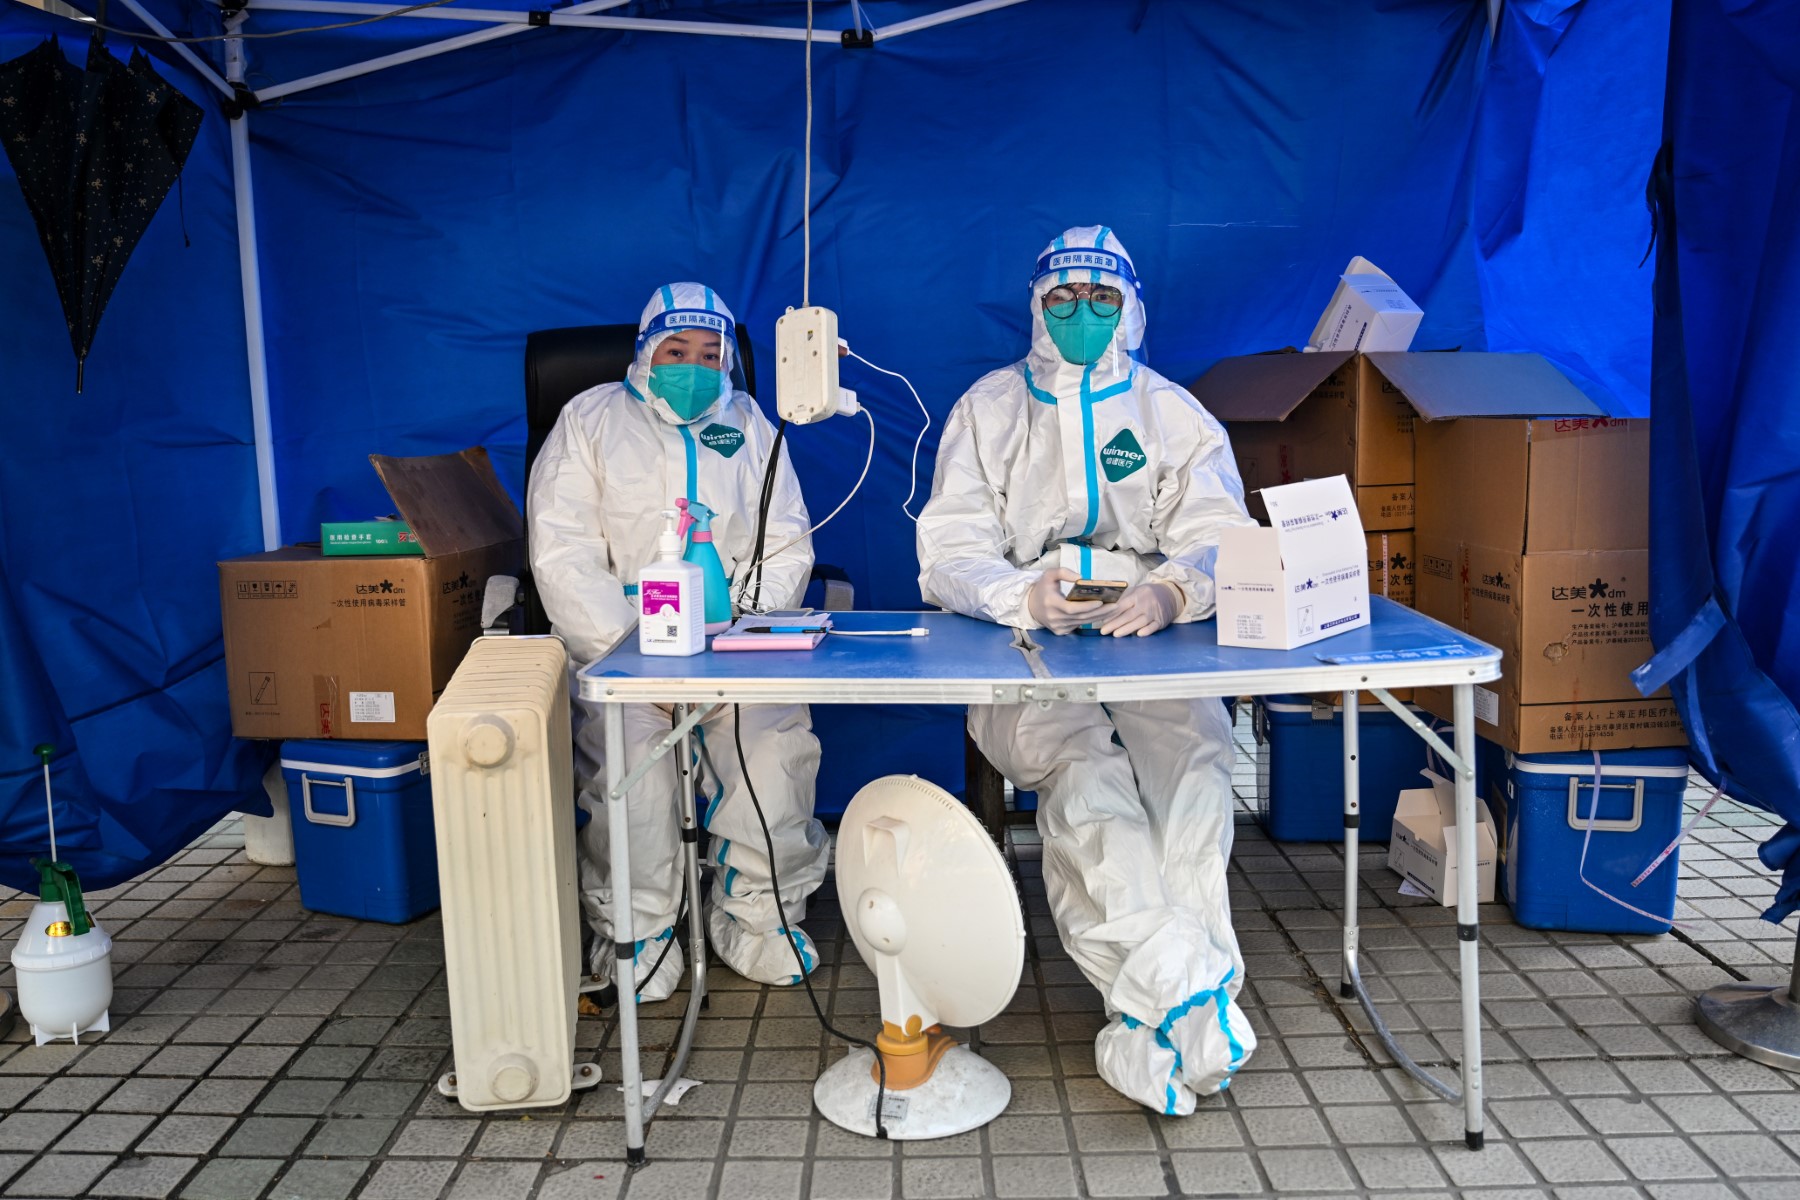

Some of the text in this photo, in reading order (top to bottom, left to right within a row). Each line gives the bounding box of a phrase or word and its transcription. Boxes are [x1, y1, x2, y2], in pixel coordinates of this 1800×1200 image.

[1053, 254, 1113, 267] 医用隔离面罩
[1554, 417, 1589, 433] 达美
[700, 432, 742, 440] winner
[1103, 445, 1145, 461] winner
[356, 584, 379, 594] 达美
[1551, 586, 1626, 600] 达美 dm
[331, 598, 405, 608] 一次性使用病毒采样管
[1571, 602, 1648, 618] 一次性使用
[320, 703, 331, 734] 达美
